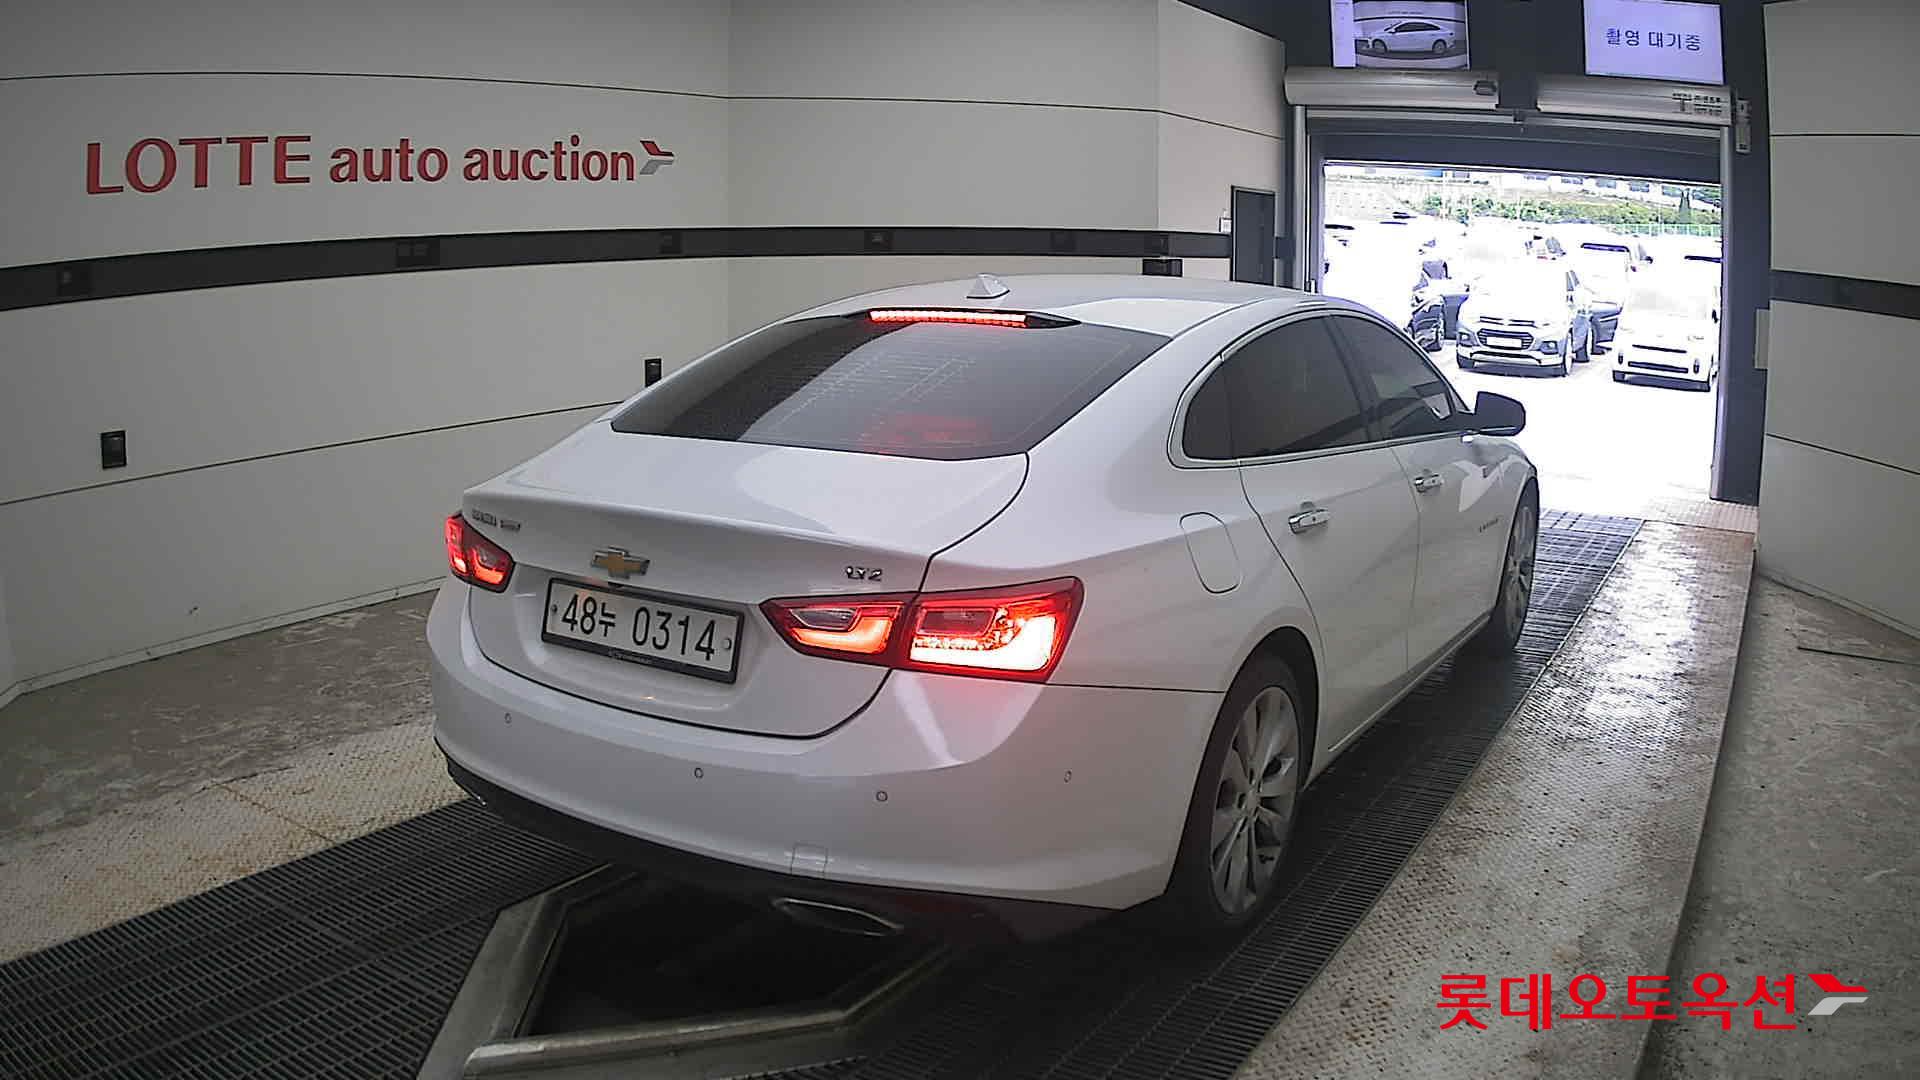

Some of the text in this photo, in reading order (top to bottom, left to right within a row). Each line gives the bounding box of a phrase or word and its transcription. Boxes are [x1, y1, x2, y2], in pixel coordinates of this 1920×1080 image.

[1607, 28, 1702, 51] 촬영 대기중
[86, 134, 635, 195] LOTTE auto auction
[561, 593, 716, 661] 48누 0314
